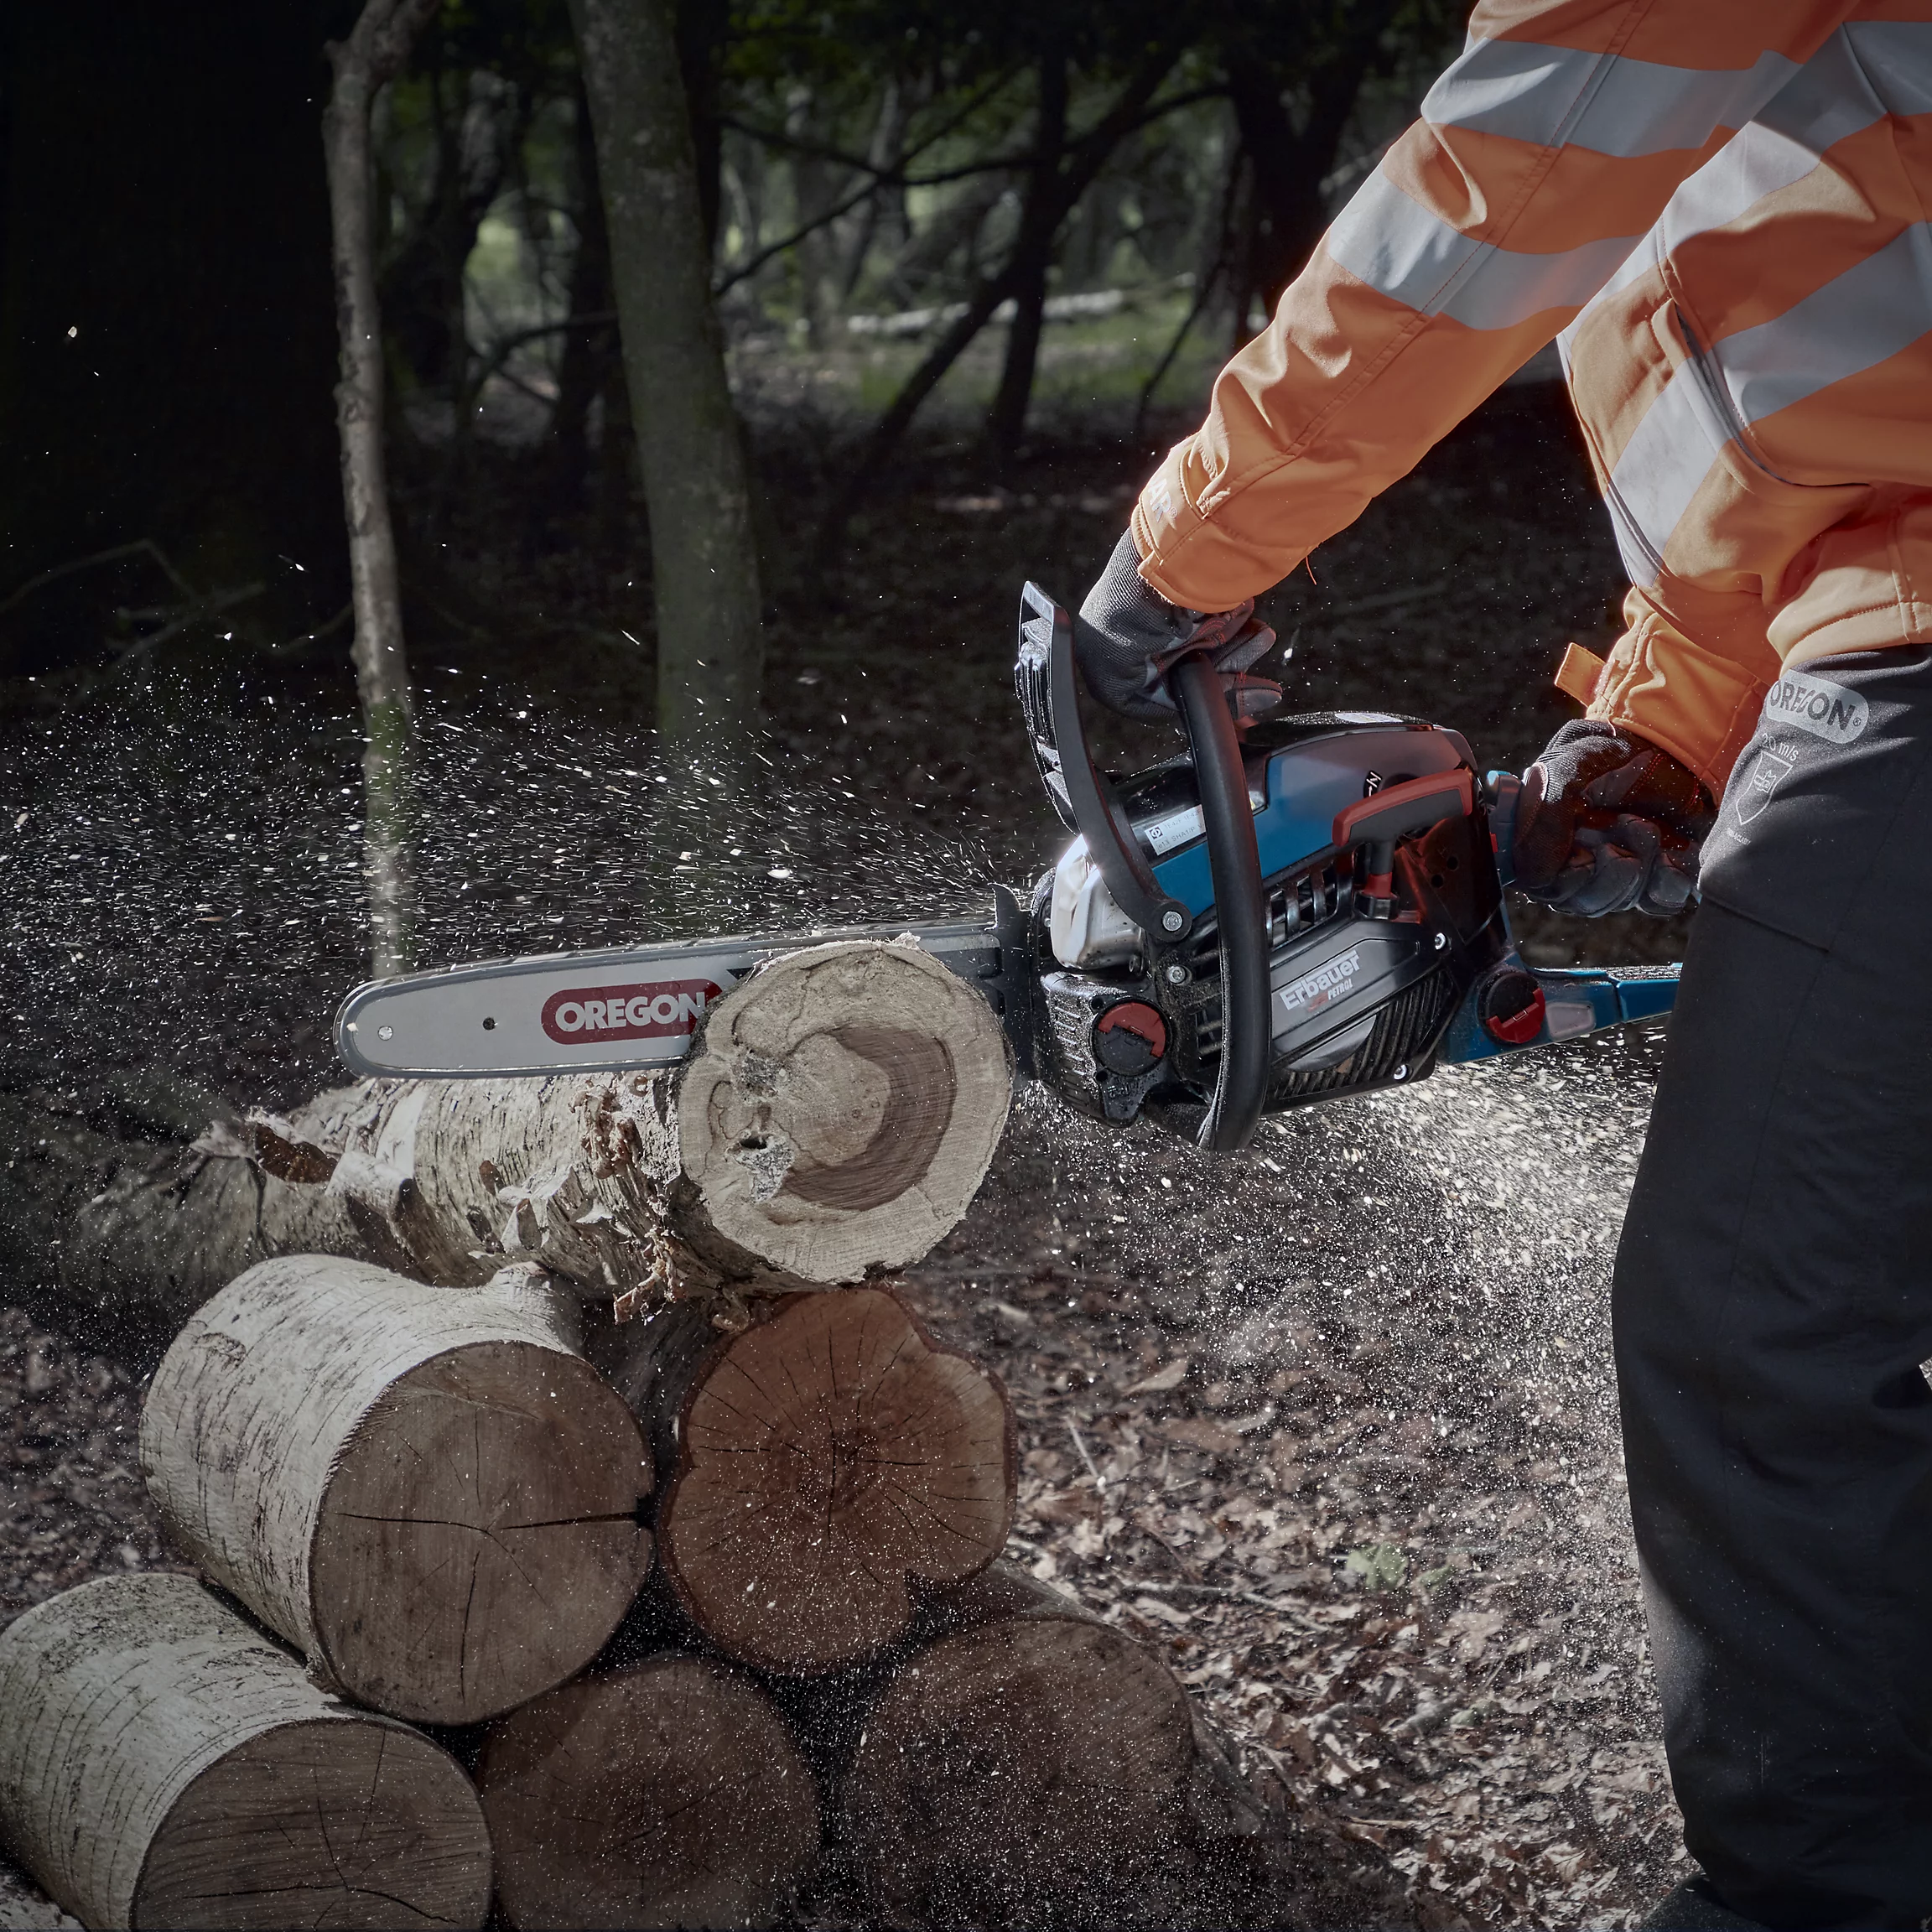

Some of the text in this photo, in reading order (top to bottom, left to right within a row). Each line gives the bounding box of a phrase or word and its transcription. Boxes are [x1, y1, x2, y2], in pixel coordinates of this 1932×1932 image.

[1762, 733, 1799, 761] 20 m/s
[1279, 949, 1360, 1010] Erbauer
[1327, 978, 1353, 1000] PETROL
[555, 992, 706, 1032] OREGON
